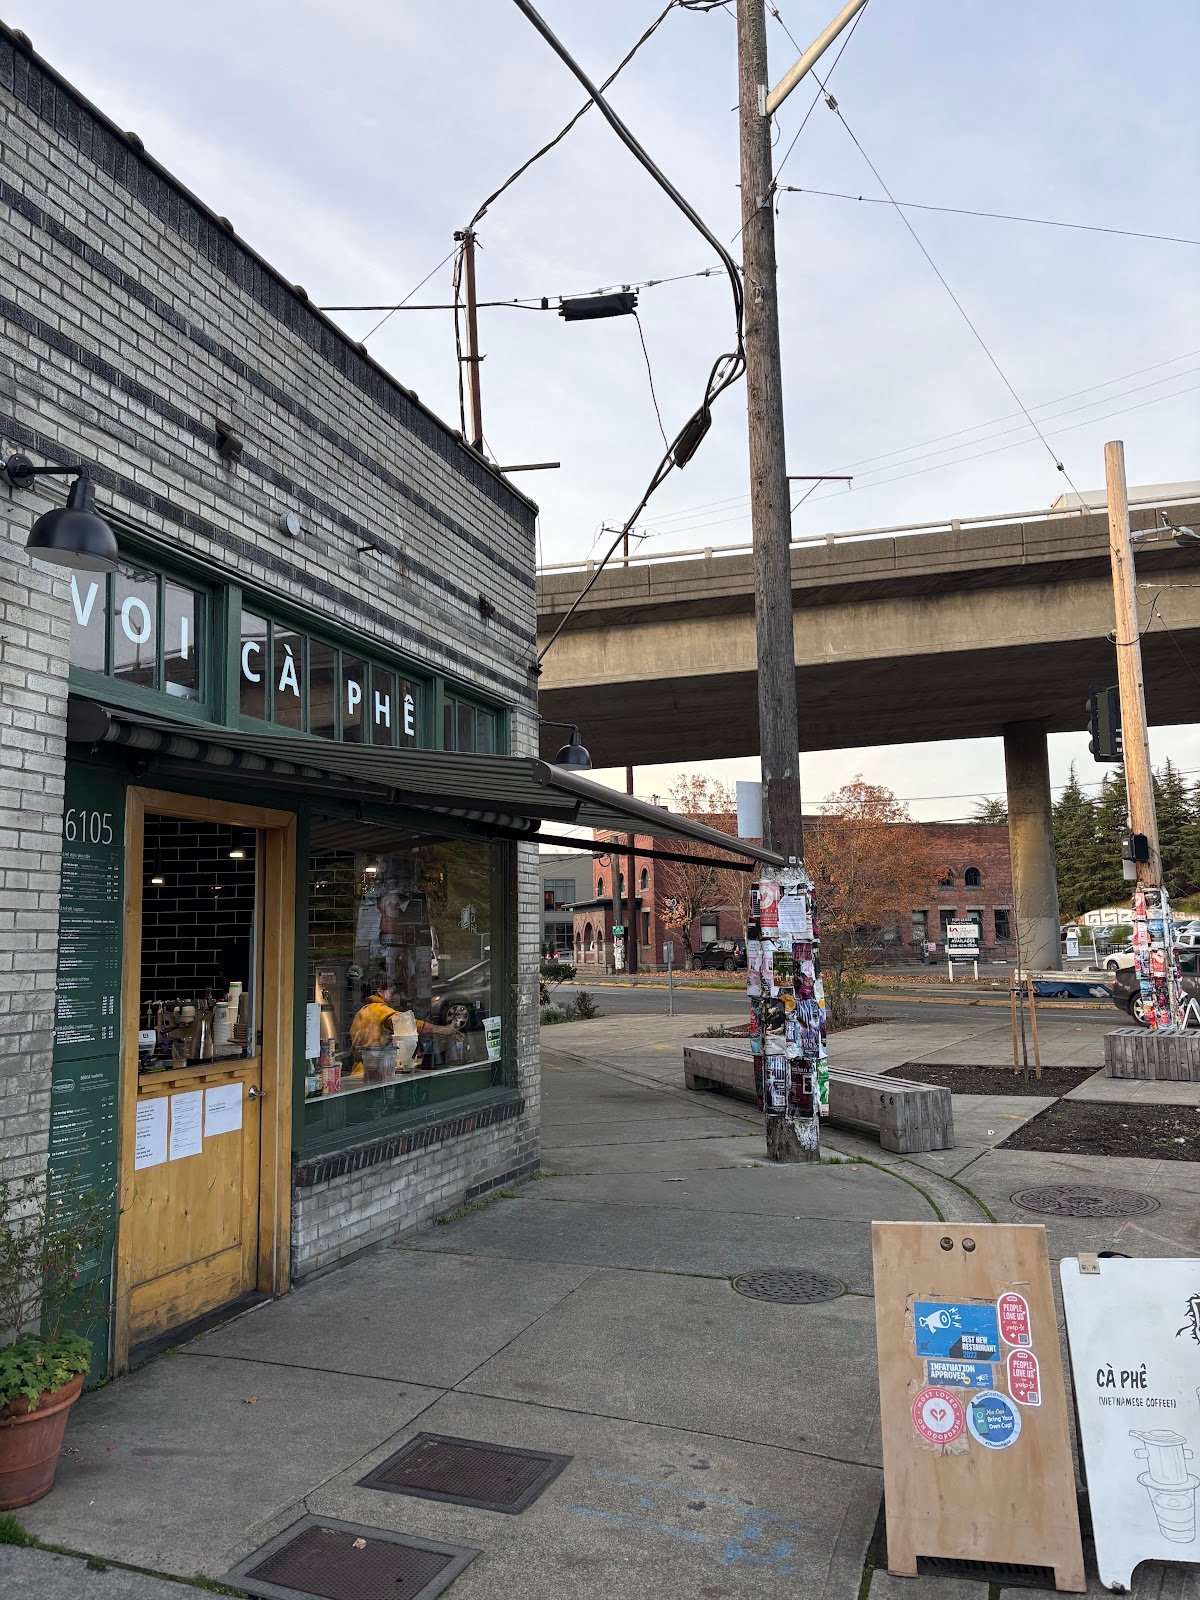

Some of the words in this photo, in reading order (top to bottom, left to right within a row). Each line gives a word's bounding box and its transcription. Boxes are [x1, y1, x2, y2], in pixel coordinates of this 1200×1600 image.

[71, 575, 189, 660] VOI
[241, 641, 300, 697] CÀ
[347, 680, 415, 737] PHÊ
[65, 808, 113, 844] 6105
[1003, 1303, 1023, 1313] PEOPLE
[1003, 1311, 1017, 1320] LOVE
[1016, 1313, 1025, 1321] US
[961, 1335, 975, 1343] BEST
[976, 1336, 988, 1344] NEW
[961, 1343, 996, 1353] RESTAURANT
[962, 1351, 977, 1359] 2022
[930, 1362, 975, 1373] INFATUATION
[1013, 1360, 1033, 1369] PEOPLE
[930, 1370, 966, 1380] APPROVED
[1012, 1369, 1027, 1378] LOVE
[1026, 1369, 1035, 1379] US
[1096, 1363, 1116, 1388] CÀ
[1120, 1363, 1148, 1389] PHÊ
[918, 1391, 933, 1408] MOST
[935, 1391, 958, 1409] LOVED
[1098, 1396, 1143, 1407] (VIETNAMESE
[1146, 1398, 1177, 1408] COFFEE!)
[987, 1415, 1001, 1423] Bring
[917, 1418, 926, 1432] ON
[927, 1420, 961, 1440] DOORDASH
